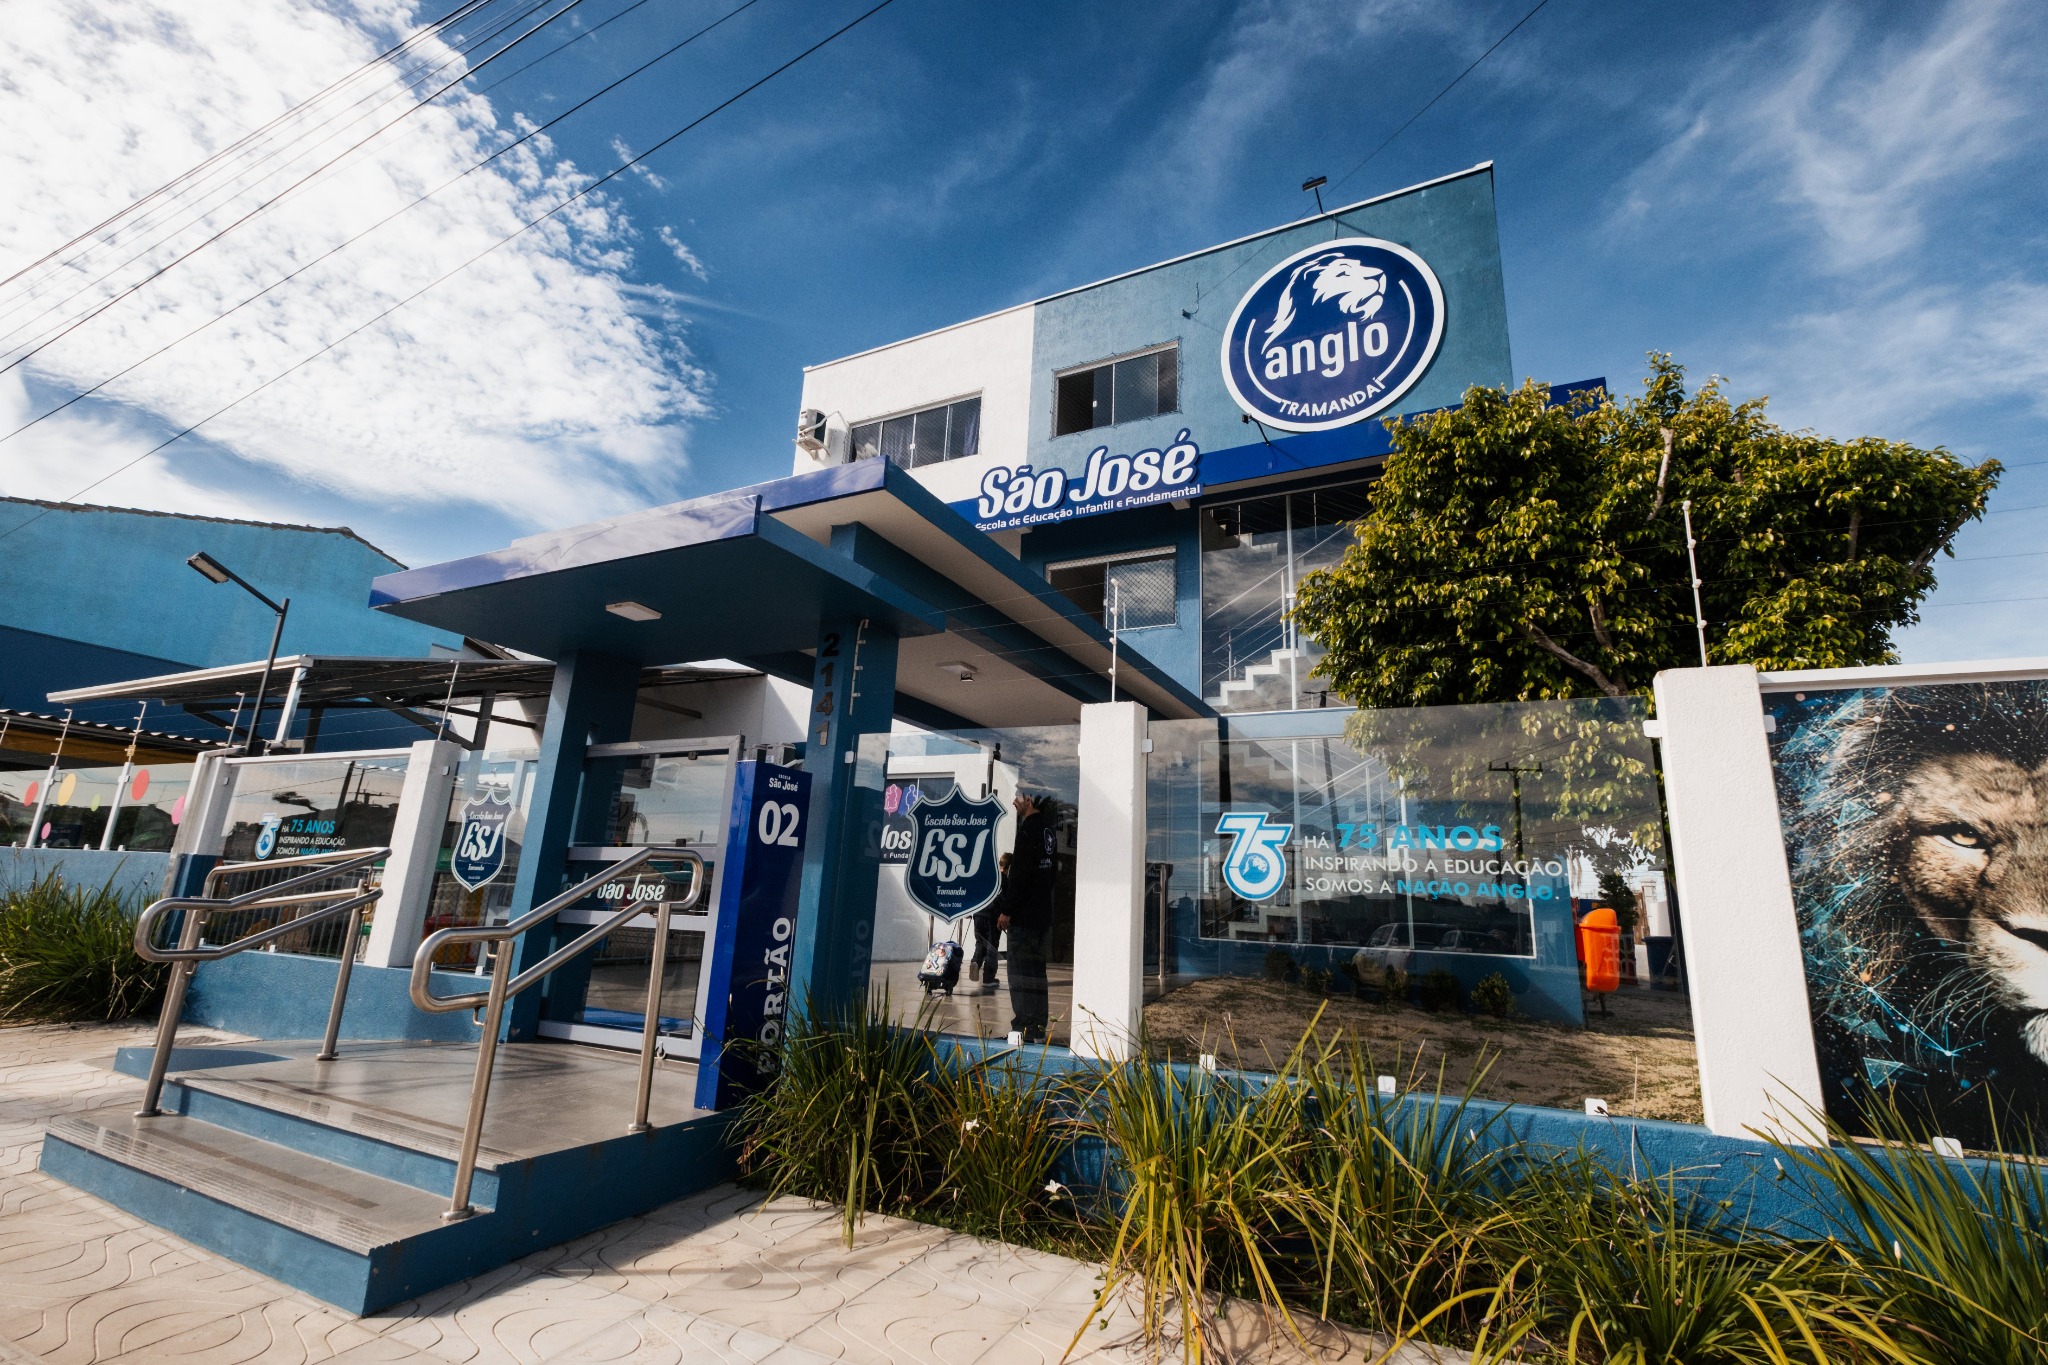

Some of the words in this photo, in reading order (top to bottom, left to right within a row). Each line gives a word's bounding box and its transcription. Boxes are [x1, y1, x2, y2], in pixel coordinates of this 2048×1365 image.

[1264, 322, 1389, 380] anglo
[1279, 376, 1386, 417] TRAMANDAÍ
[978, 467, 1064, 519] São
[1069, 430, 1197, 502] José
[975, 519, 1007, 531] Escola
[1009, 517, 1021, 527] de
[1023, 508, 1073, 524] Educação
[1076, 500, 1114, 515] Infantil
[1116, 500, 1123, 508] e
[1126, 483, 1201, 507] Fundamental
[815, 632, 840, 747] 2141
[768, 777, 782, 789] São
[782, 780, 799, 792] José
[291, 819, 304, 833] 75
[304, 820, 336, 835] ANOS
[758, 800, 800, 848] 02
[924, 813, 951, 826] Escola
[951, 813, 967, 826] São
[967, 813, 988, 826] José
[278, 836, 310, 845] INSPIRANDO
[880, 824, 912, 850] Jos
[1304, 831, 1330, 849] HÁ
[1336, 823, 1378, 850] 75
[1391, 824, 1505, 852] ANOS
[275, 846, 296, 855] SOMOS
[918, 828, 991, 883] ESJ
[1305, 856, 1419, 873] INSPIRANDO
[1424, 858, 1439, 873] A
[1444, 856, 1569, 880] EDUCAÇÃO.
[627, 874, 666, 900] José
[1305, 877, 1374, 894] SOMOS
[1379, 879, 1393, 894] A
[1397, 877, 1470, 900] NAÇÃO
